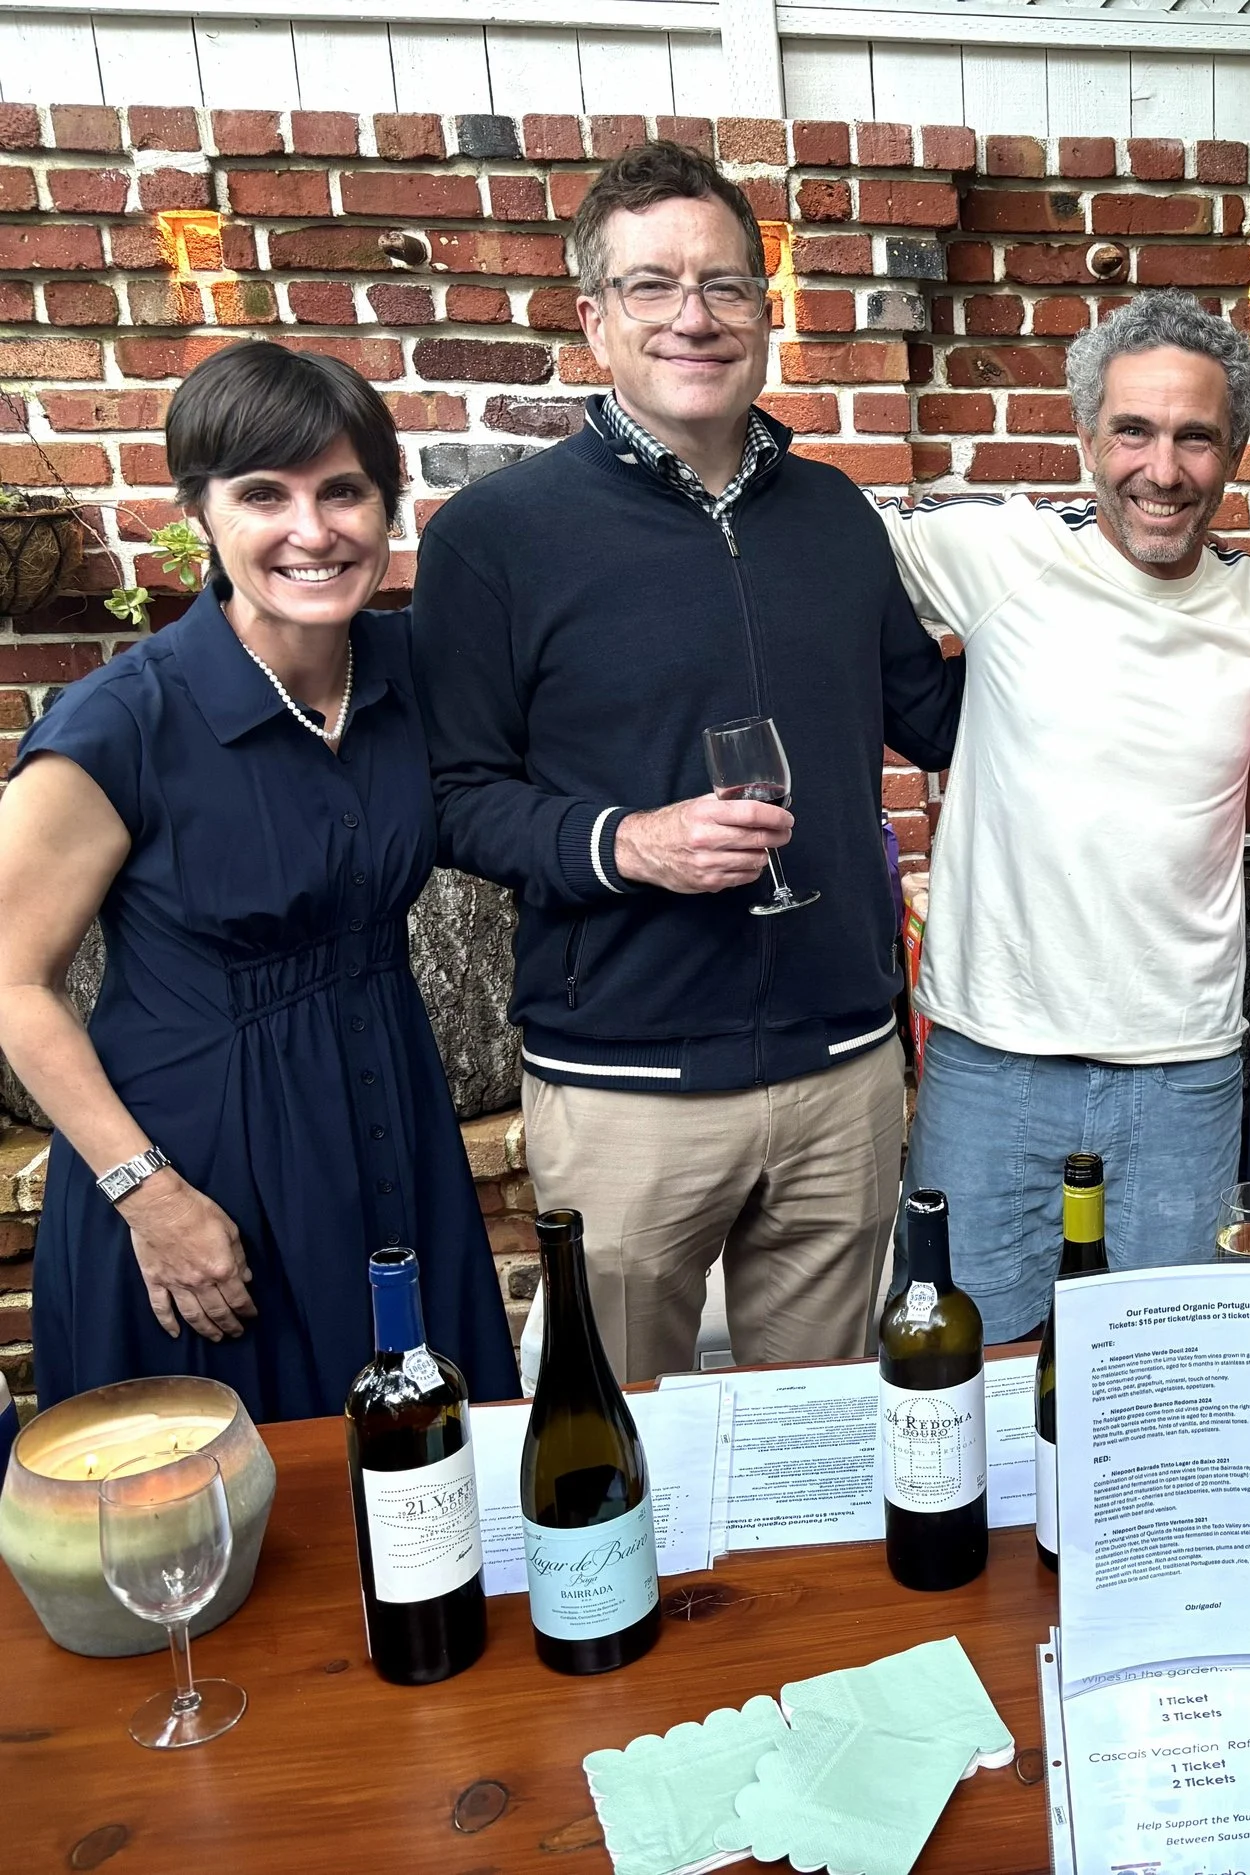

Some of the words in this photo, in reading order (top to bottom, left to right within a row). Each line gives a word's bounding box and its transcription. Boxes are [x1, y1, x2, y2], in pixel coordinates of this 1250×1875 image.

[1126, 1308, 1141, 1317] Our
[1143, 1304, 1180, 1315] Featured
[1182, 1302, 1215, 1312] Organic
[1108, 1320, 1137, 1330] Tickets:
[1138, 1318, 1152, 1326] $15
[1153, 1316, 1166, 1325] per
[1167, 1312, 1211, 1324] ticket/glass
[1091, 1340, 1115, 1350] WHITE:
[905, 1412, 972, 1429] REDOMA
[902, 1428, 948, 1438] DOURO
[1093, 1455, 1111, 1465] RED:
[529, 1546, 568, 1577] Lagar
[569, 1549, 592, 1572] de
[560, 1584, 613, 1599] BAIRRADA
[1184, 1601, 1222, 1611] Obrigado!
[1141, 1669, 1162, 1679] the
[1166, 1694, 1208, 1705] Ticket
[1161, 1713, 1170, 1722] 3
[1173, 1709, 1222, 1721] Tickets
[1088, 1748, 1147, 1763] Cascais
[1151, 1742, 1219, 1757] Vacation
[1171, 1764, 1177, 1773] 1
[1181, 1759, 1226, 1772] Ticket
[1172, 1779, 1181, 1789] 2
[1184, 1774, 1236, 1788] Tickets
[1136, 1821, 1162, 1832] Help
[1164, 1816, 1208, 1830] Support
[1211, 1814, 1229, 1824] the
[1166, 1834, 1215, 1846] Between
